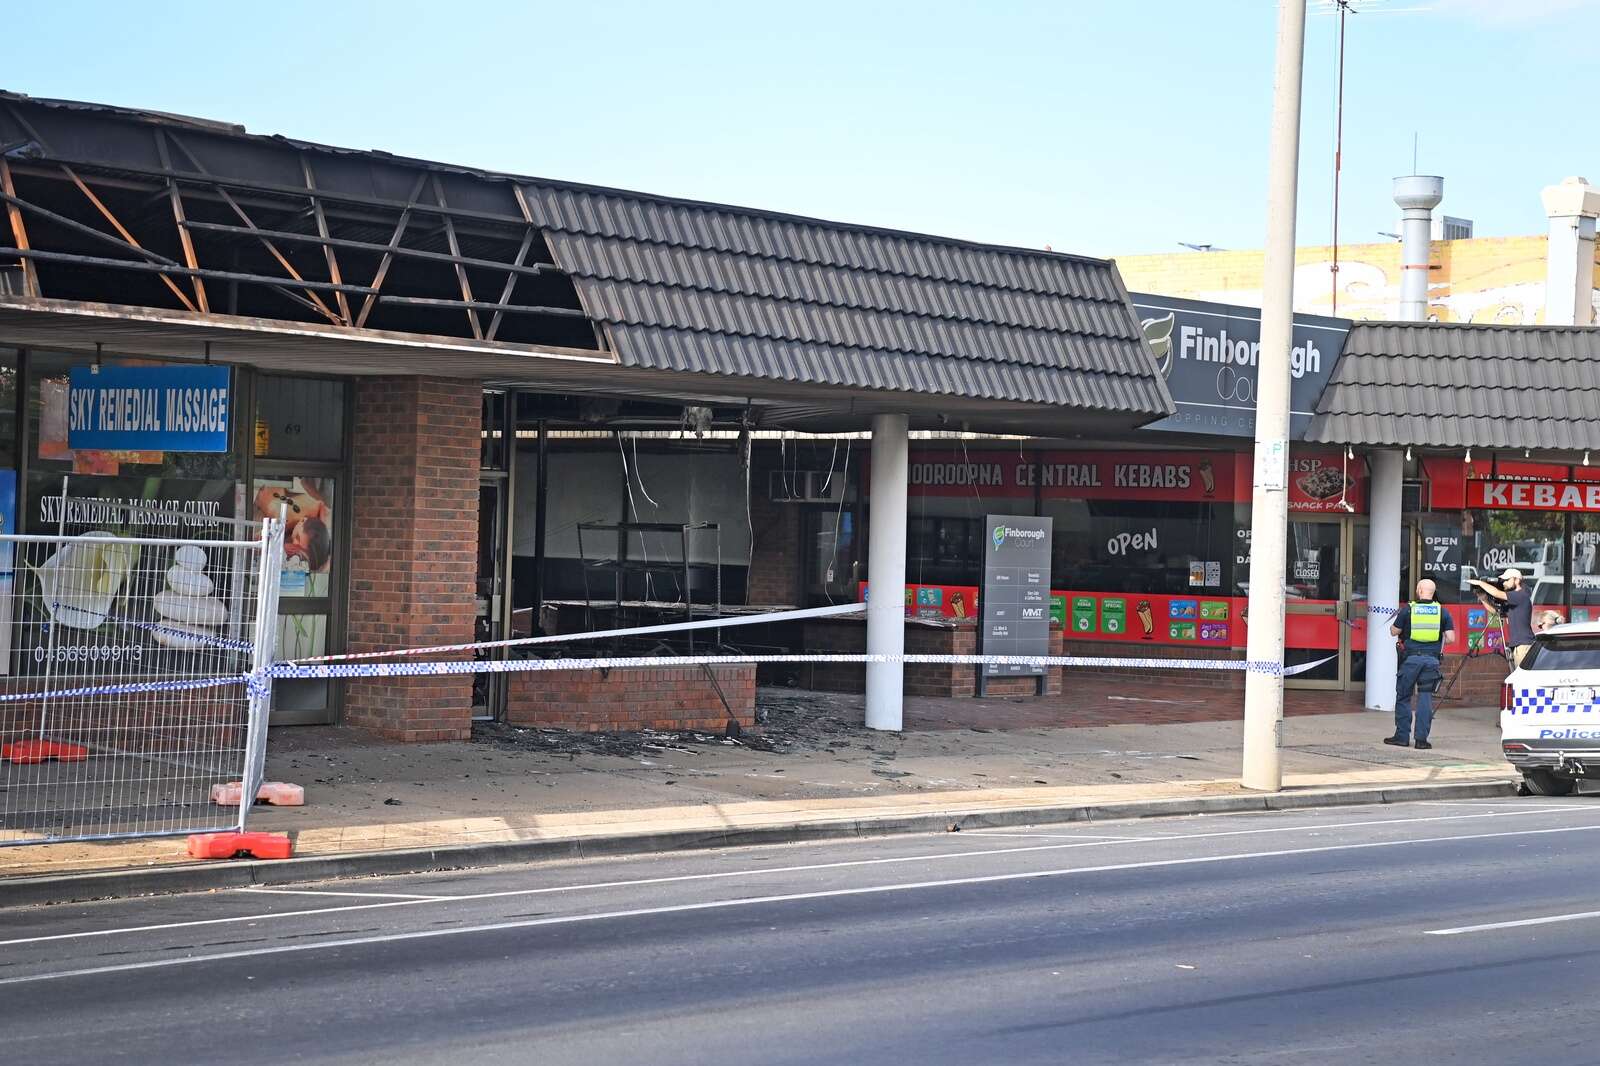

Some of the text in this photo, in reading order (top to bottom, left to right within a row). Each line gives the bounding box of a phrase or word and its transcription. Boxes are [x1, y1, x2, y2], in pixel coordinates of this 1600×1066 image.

[1179, 325, 1320, 378] Finborgh
[1216, 366, 1257, 402] Cou
[70, 388, 227, 433] SKY REMEDIAL MASSAGE
[1015, 463, 1102, 487] CENTRAL
[1114, 464, 1192, 489] KEBABS
[40, 496, 220, 527] SKY REMEDIAL MASSAGE CLINIC
[1004, 527, 1045, 540] Finborough
[1424, 536, 1459, 546] OPEN
[1433, 546, 1449, 563] 7
[1295, 568, 1319, 577] CLOSED
[1424, 562, 1457, 572] DAYS
[1022, 608, 1043, 617] MMT
[1414, 606, 1438, 614] Police
[1539, 728, 1600, 739] Police
